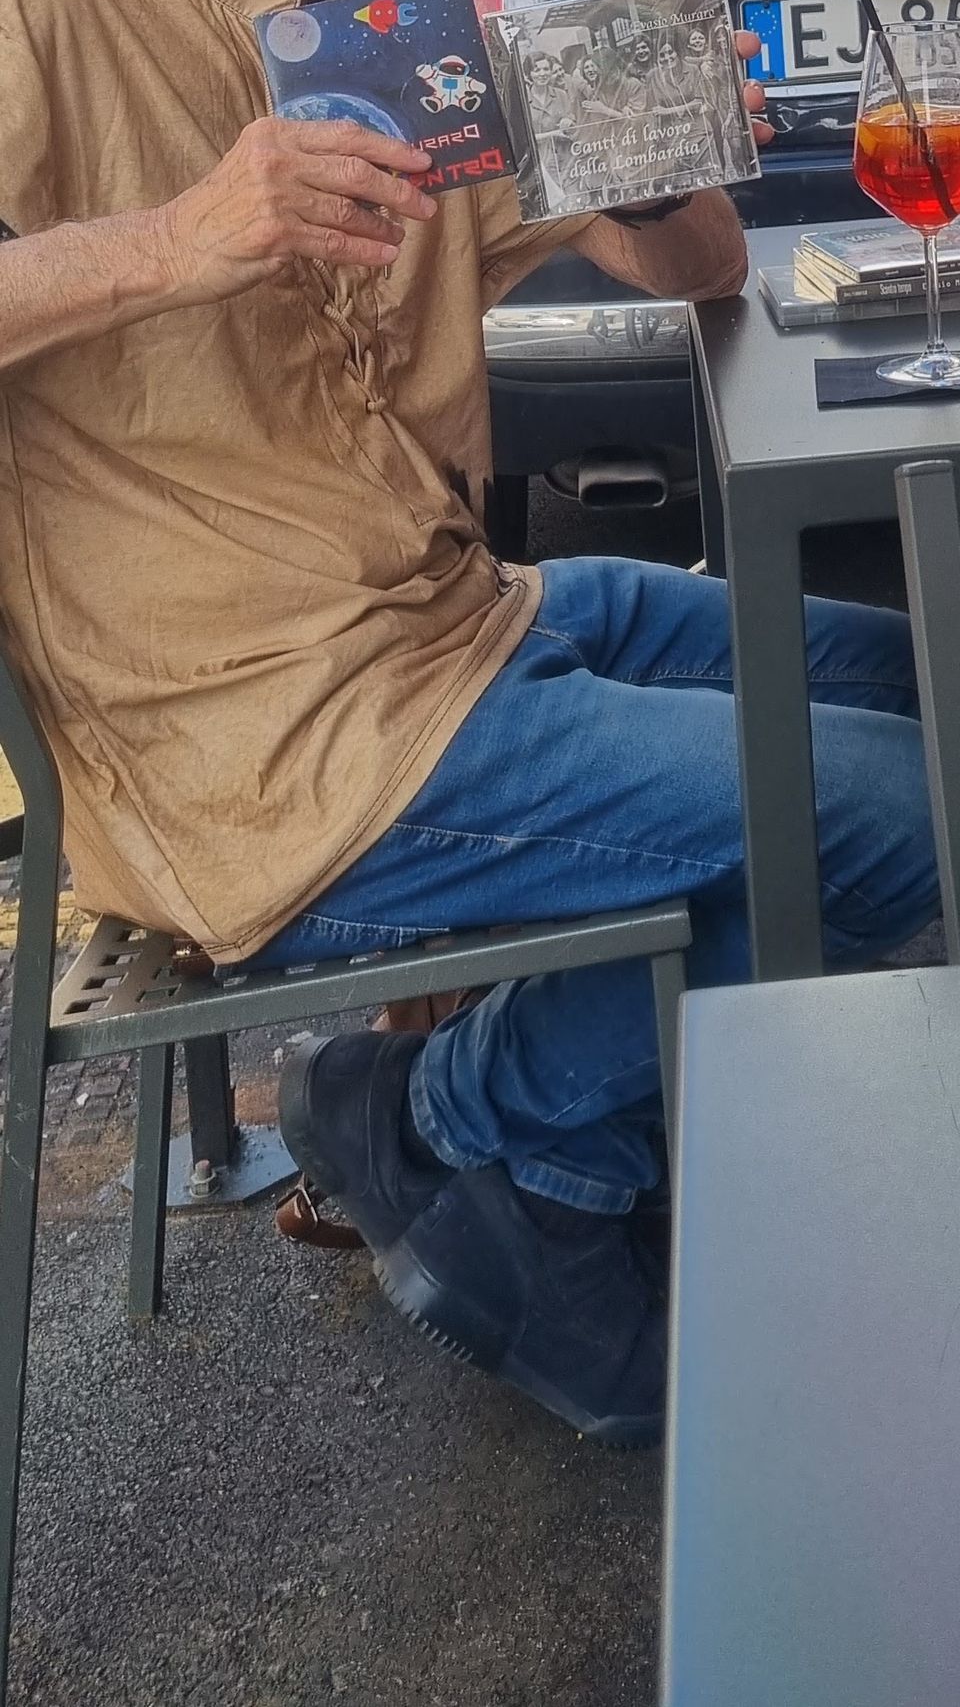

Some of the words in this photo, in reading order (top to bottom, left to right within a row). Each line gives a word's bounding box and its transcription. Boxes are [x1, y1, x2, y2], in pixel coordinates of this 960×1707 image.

[670, 8, 715, 25] Muraro
[570, 138, 615, 157] Canti
[621, 126, 637, 146] di
[643, 122, 691, 140] lavoro
[569, 158, 608, 179] della
[611, 138, 701, 170] Lombardia
